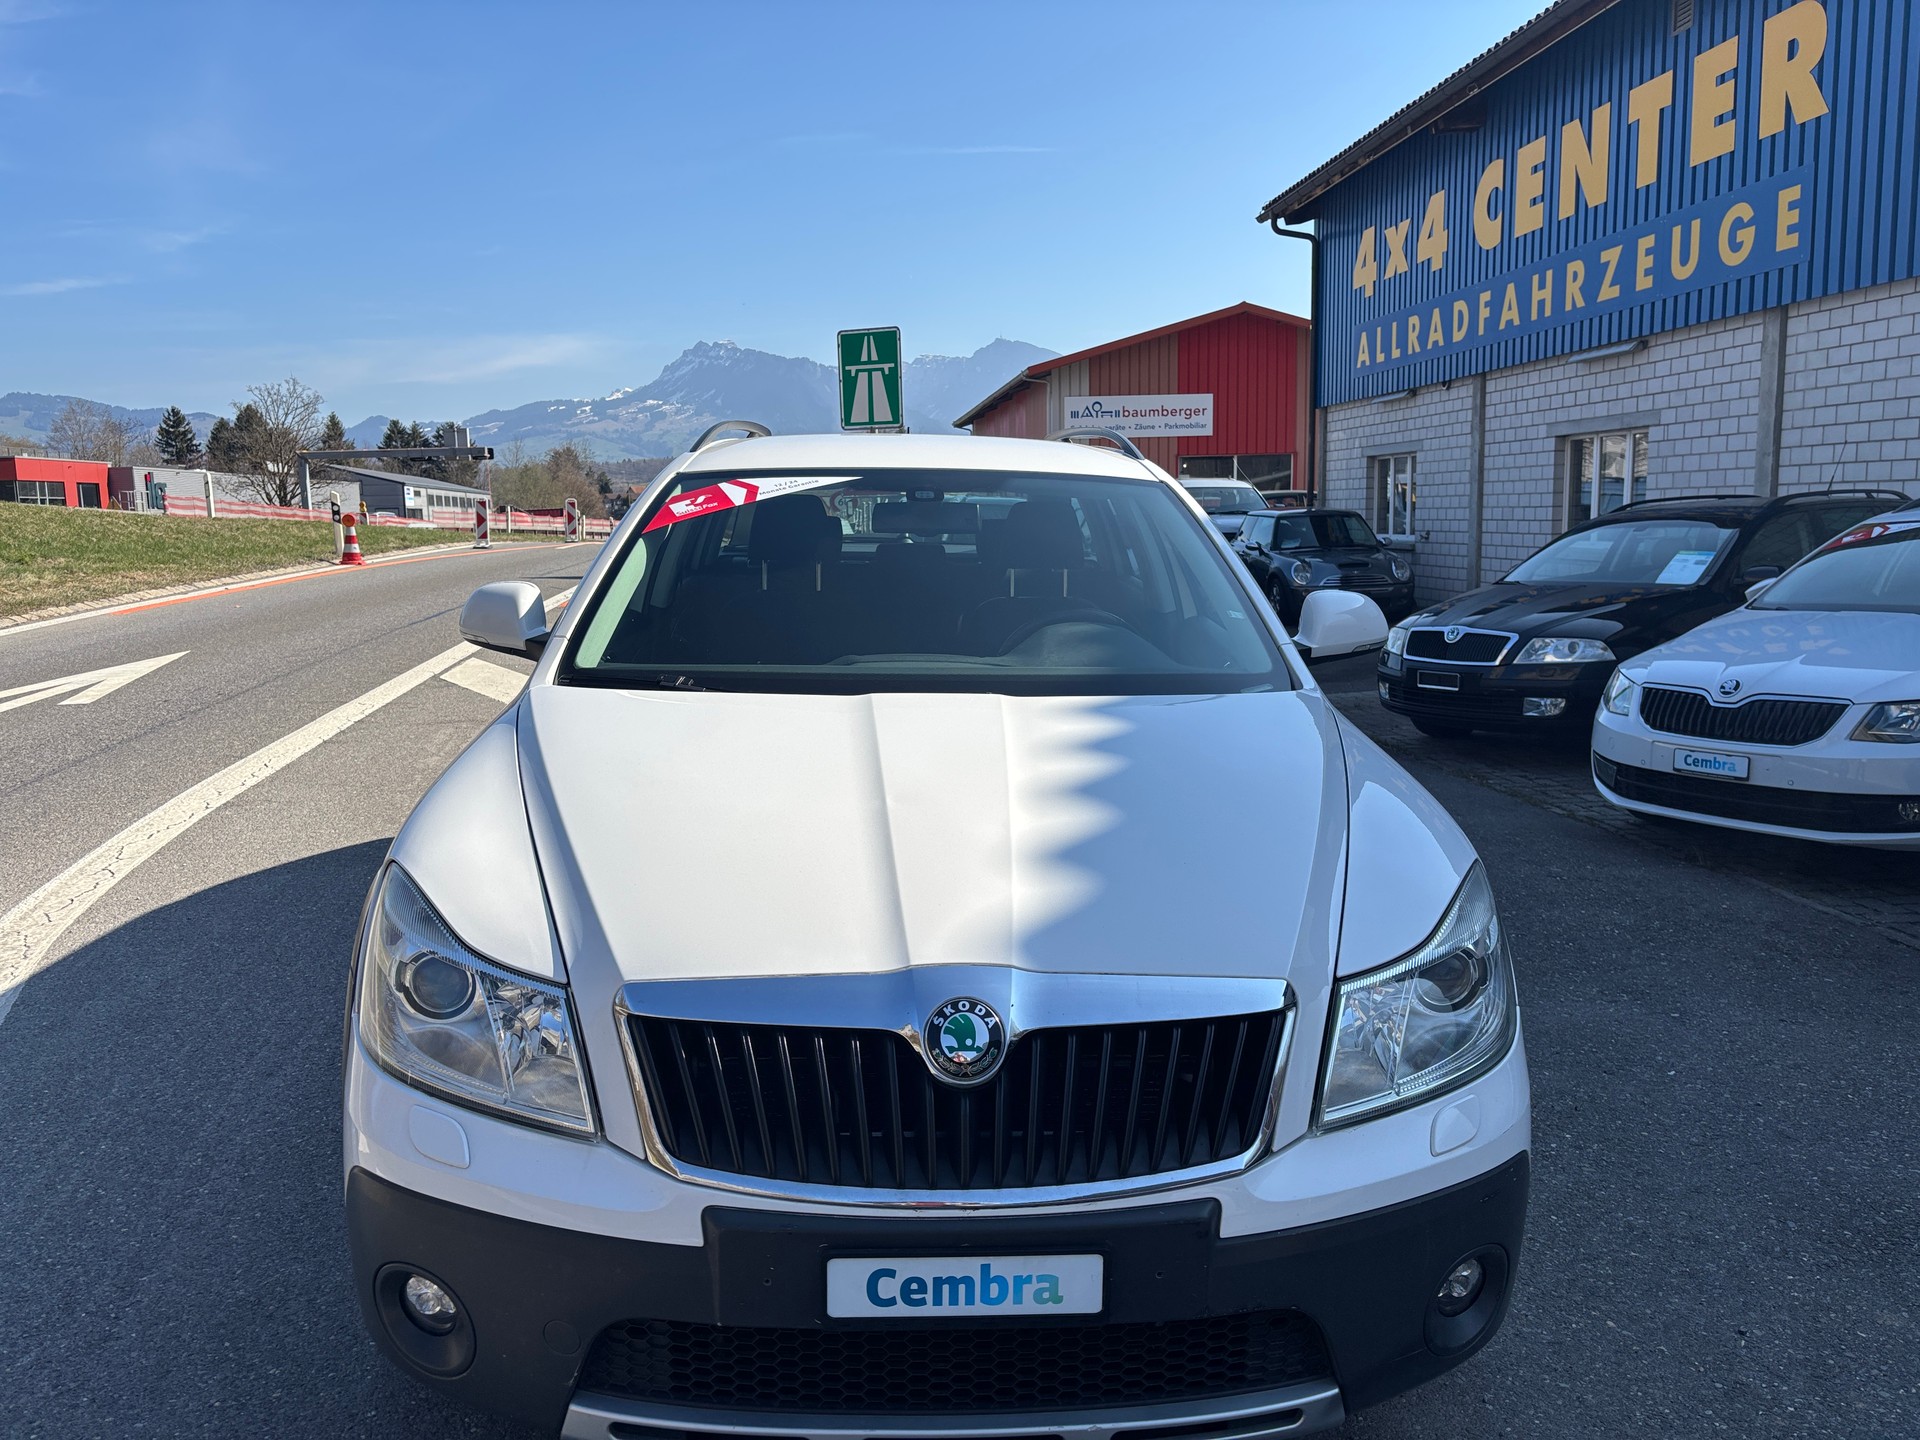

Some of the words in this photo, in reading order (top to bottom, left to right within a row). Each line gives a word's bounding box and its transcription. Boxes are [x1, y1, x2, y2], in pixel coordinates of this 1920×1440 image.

[1353, 189, 1448, 298] 4x4
[1473, 1, 1830, 251] CENTER
[1356, 184, 1802, 369] ALLRADFAHRZEUGE
[1122, 405, 1207, 420] baumberger
[1134, 423, 1156, 431] Zäune
[1164, 422, 1207, 430] Parkmobiliar
[759, 486, 787, 496] Monate
[788, 479, 819, 489] Garantie
[1683, 754, 1737, 772] Cembra
[866, 1263, 1064, 1308] Cembra
